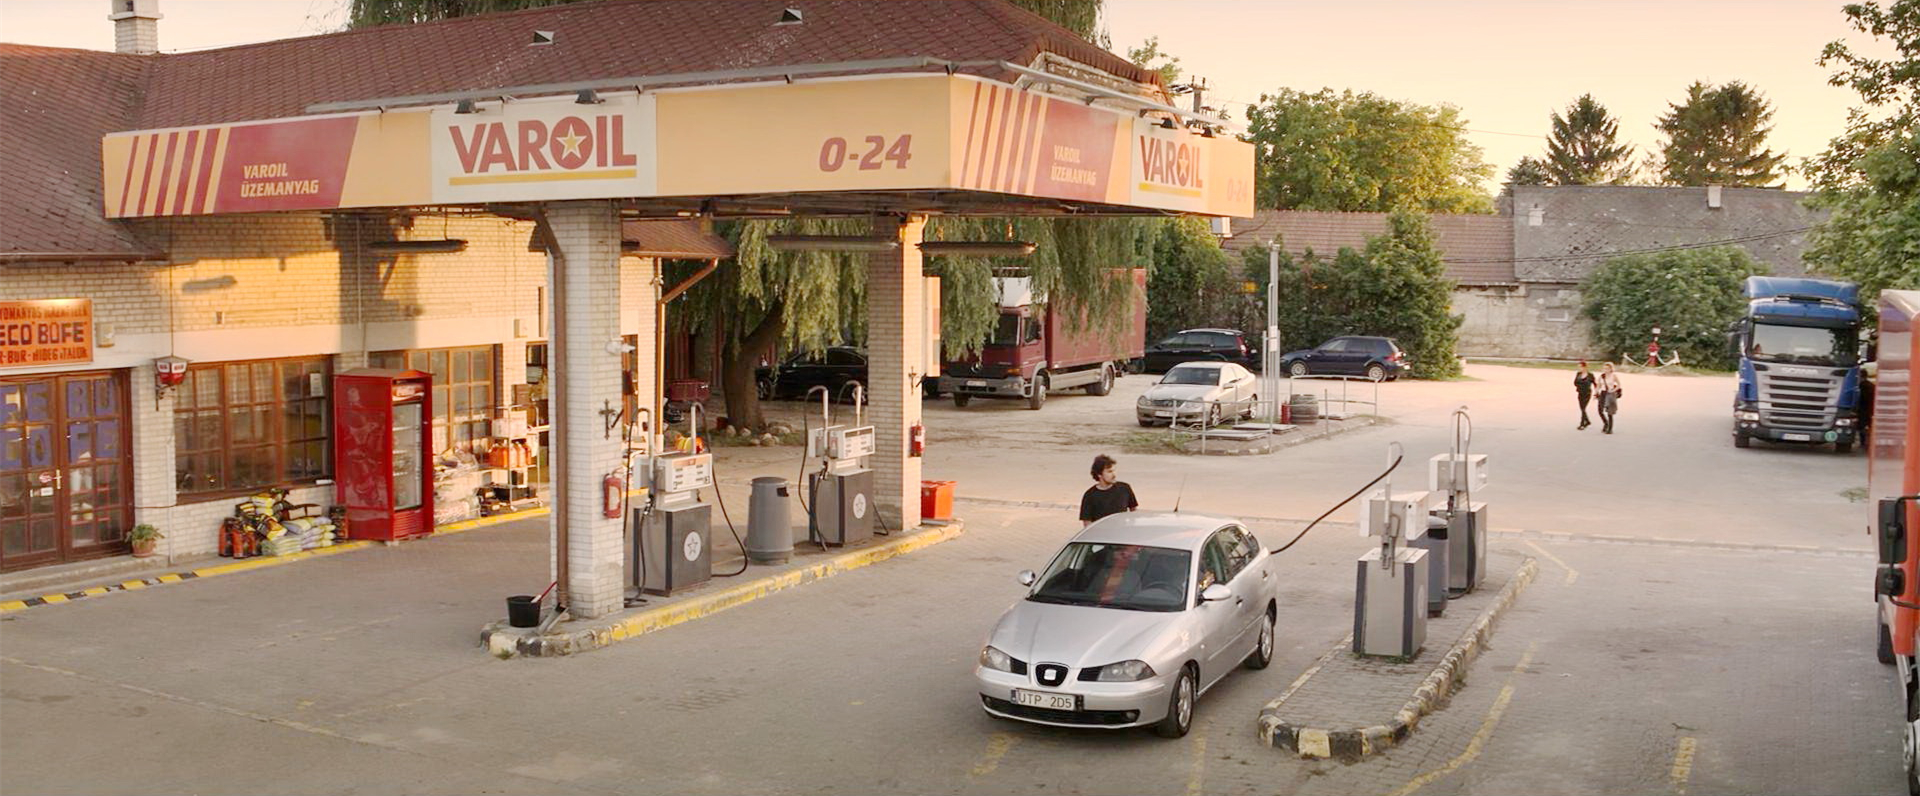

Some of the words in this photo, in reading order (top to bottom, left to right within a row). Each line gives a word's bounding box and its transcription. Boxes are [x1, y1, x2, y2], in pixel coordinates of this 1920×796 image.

[449, 115, 637, 173] VAROIL
[819, 134, 912, 172] 0-24
[1053, 144, 1081, 163] VAROIL
[243, 163, 288, 179] VAROIL
[1140, 135, 1203, 188] VAROIL
[1050, 162, 1097, 186] ÜZEMANYAG
[241, 179, 319, 198] ÜZEMANYAG
[1020, 693, 1042, 705] UTP
